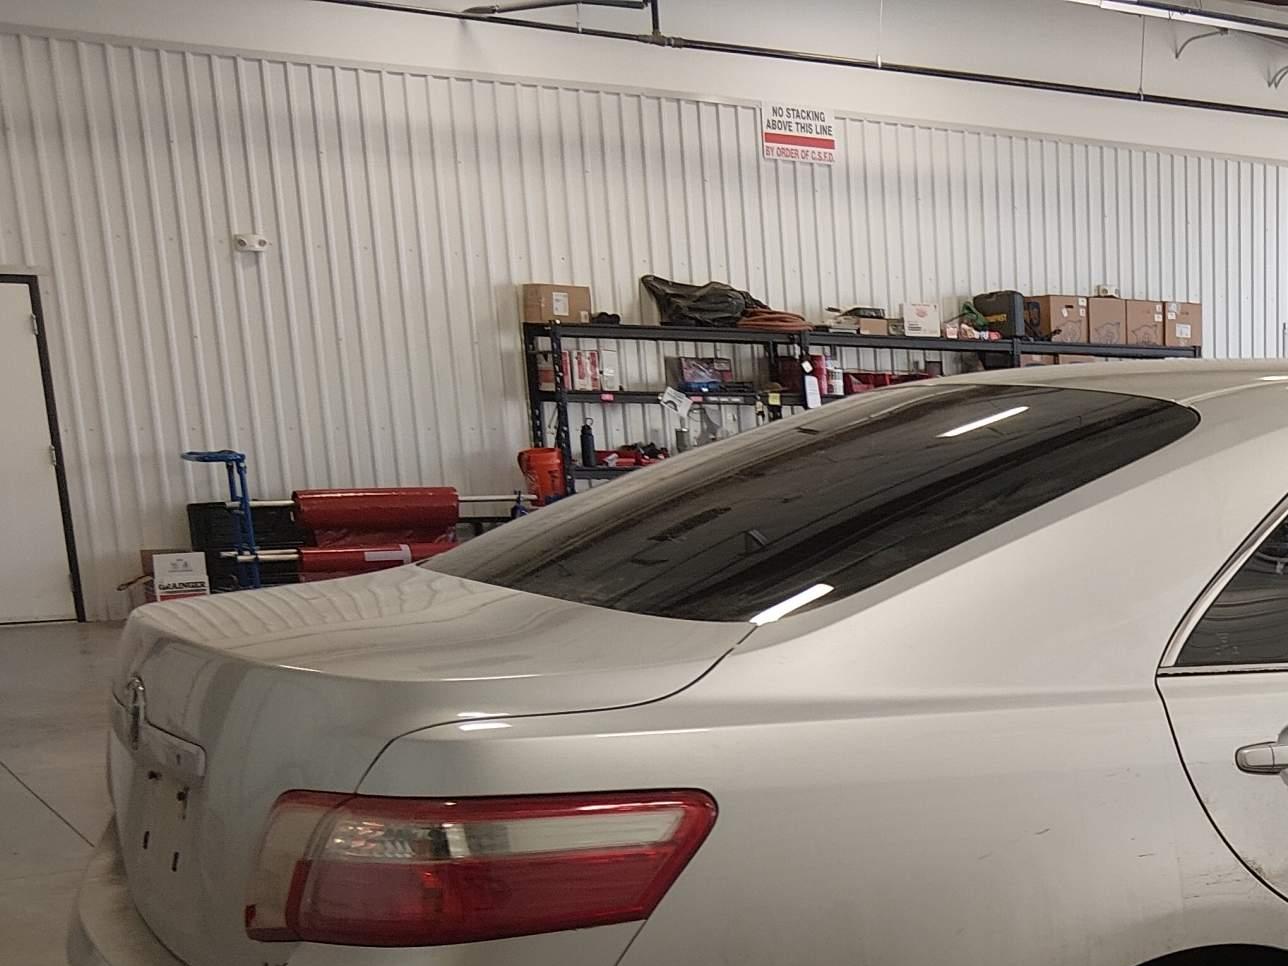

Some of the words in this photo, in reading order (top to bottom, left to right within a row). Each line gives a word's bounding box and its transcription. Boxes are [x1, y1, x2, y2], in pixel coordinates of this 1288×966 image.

[772, 106, 784, 118] NO
[786, 108, 826, 122] STACKING
[766, 119, 793, 132] ABOVE
[795, 122, 813, 134] THIS
[815, 123, 833, 136] LINE
[765, 146, 774, 156] BY
[776, 147, 800, 159] ORDER
[800, 150, 810, 160] OF
